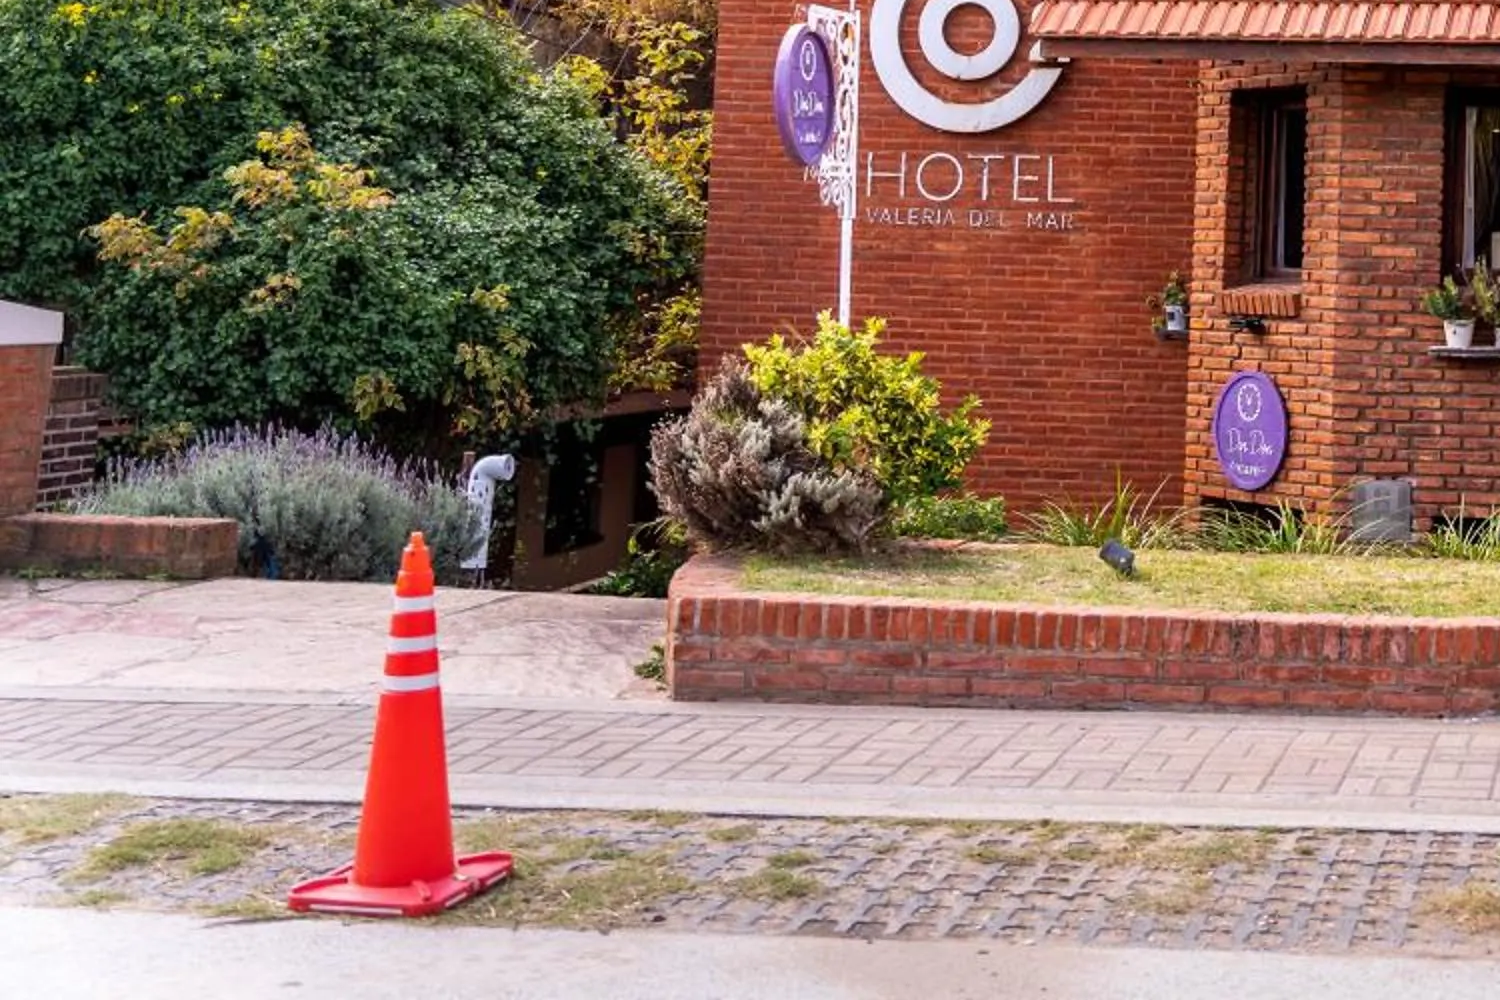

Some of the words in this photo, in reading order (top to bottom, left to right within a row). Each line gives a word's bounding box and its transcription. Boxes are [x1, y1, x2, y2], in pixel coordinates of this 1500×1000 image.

[866, 151, 1076, 202] HOTEL
[866, 207, 956, 225] VALERIA
[968, 209, 1010, 228] DEL
[1027, 211, 1074, 230] MAR
